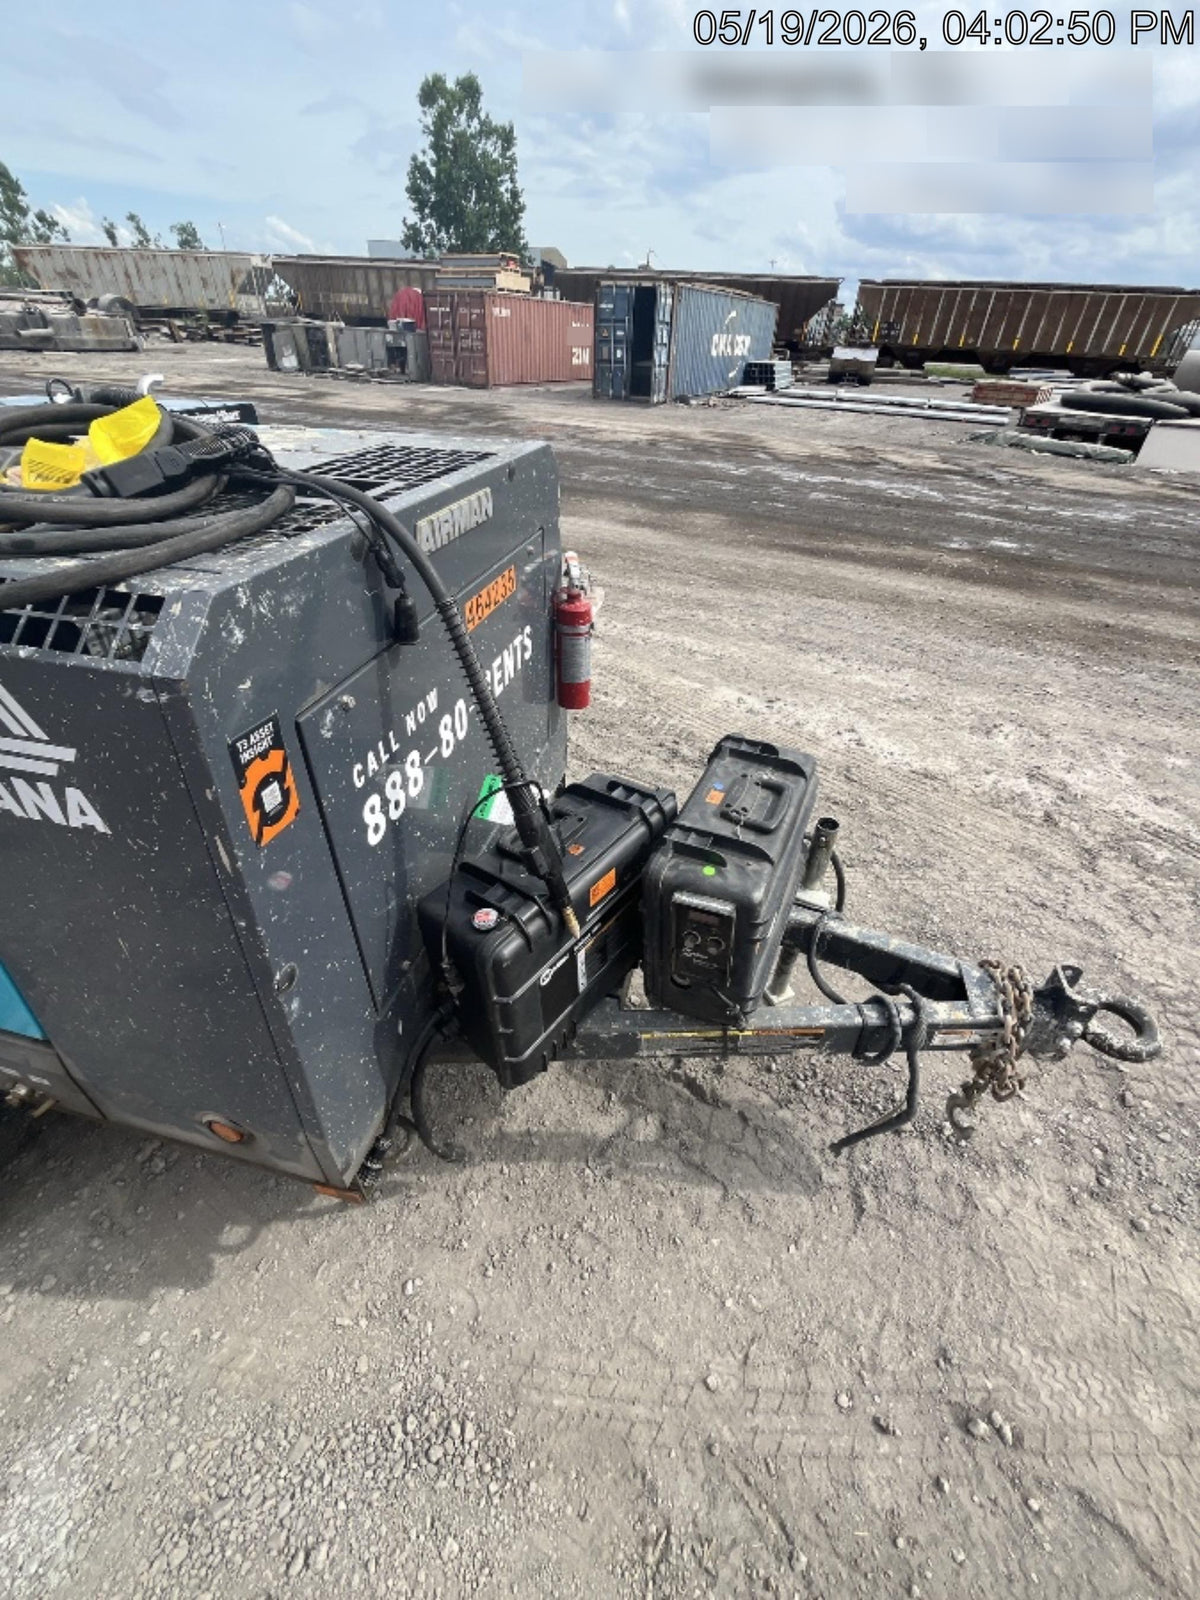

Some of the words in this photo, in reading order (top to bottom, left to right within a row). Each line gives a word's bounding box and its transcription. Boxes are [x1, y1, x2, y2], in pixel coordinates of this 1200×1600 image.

[415, 486, 494, 555] AIRMAN
[466, 567, 515, 627] 464235
[239, 733, 275, 765] INSIGHT
[250, 721, 274, 745] ASSET
[353, 730, 400, 788] CALL
[405, 687, 438, 736] NOW
[363, 624, 533, 847] 888-80-ENTS
